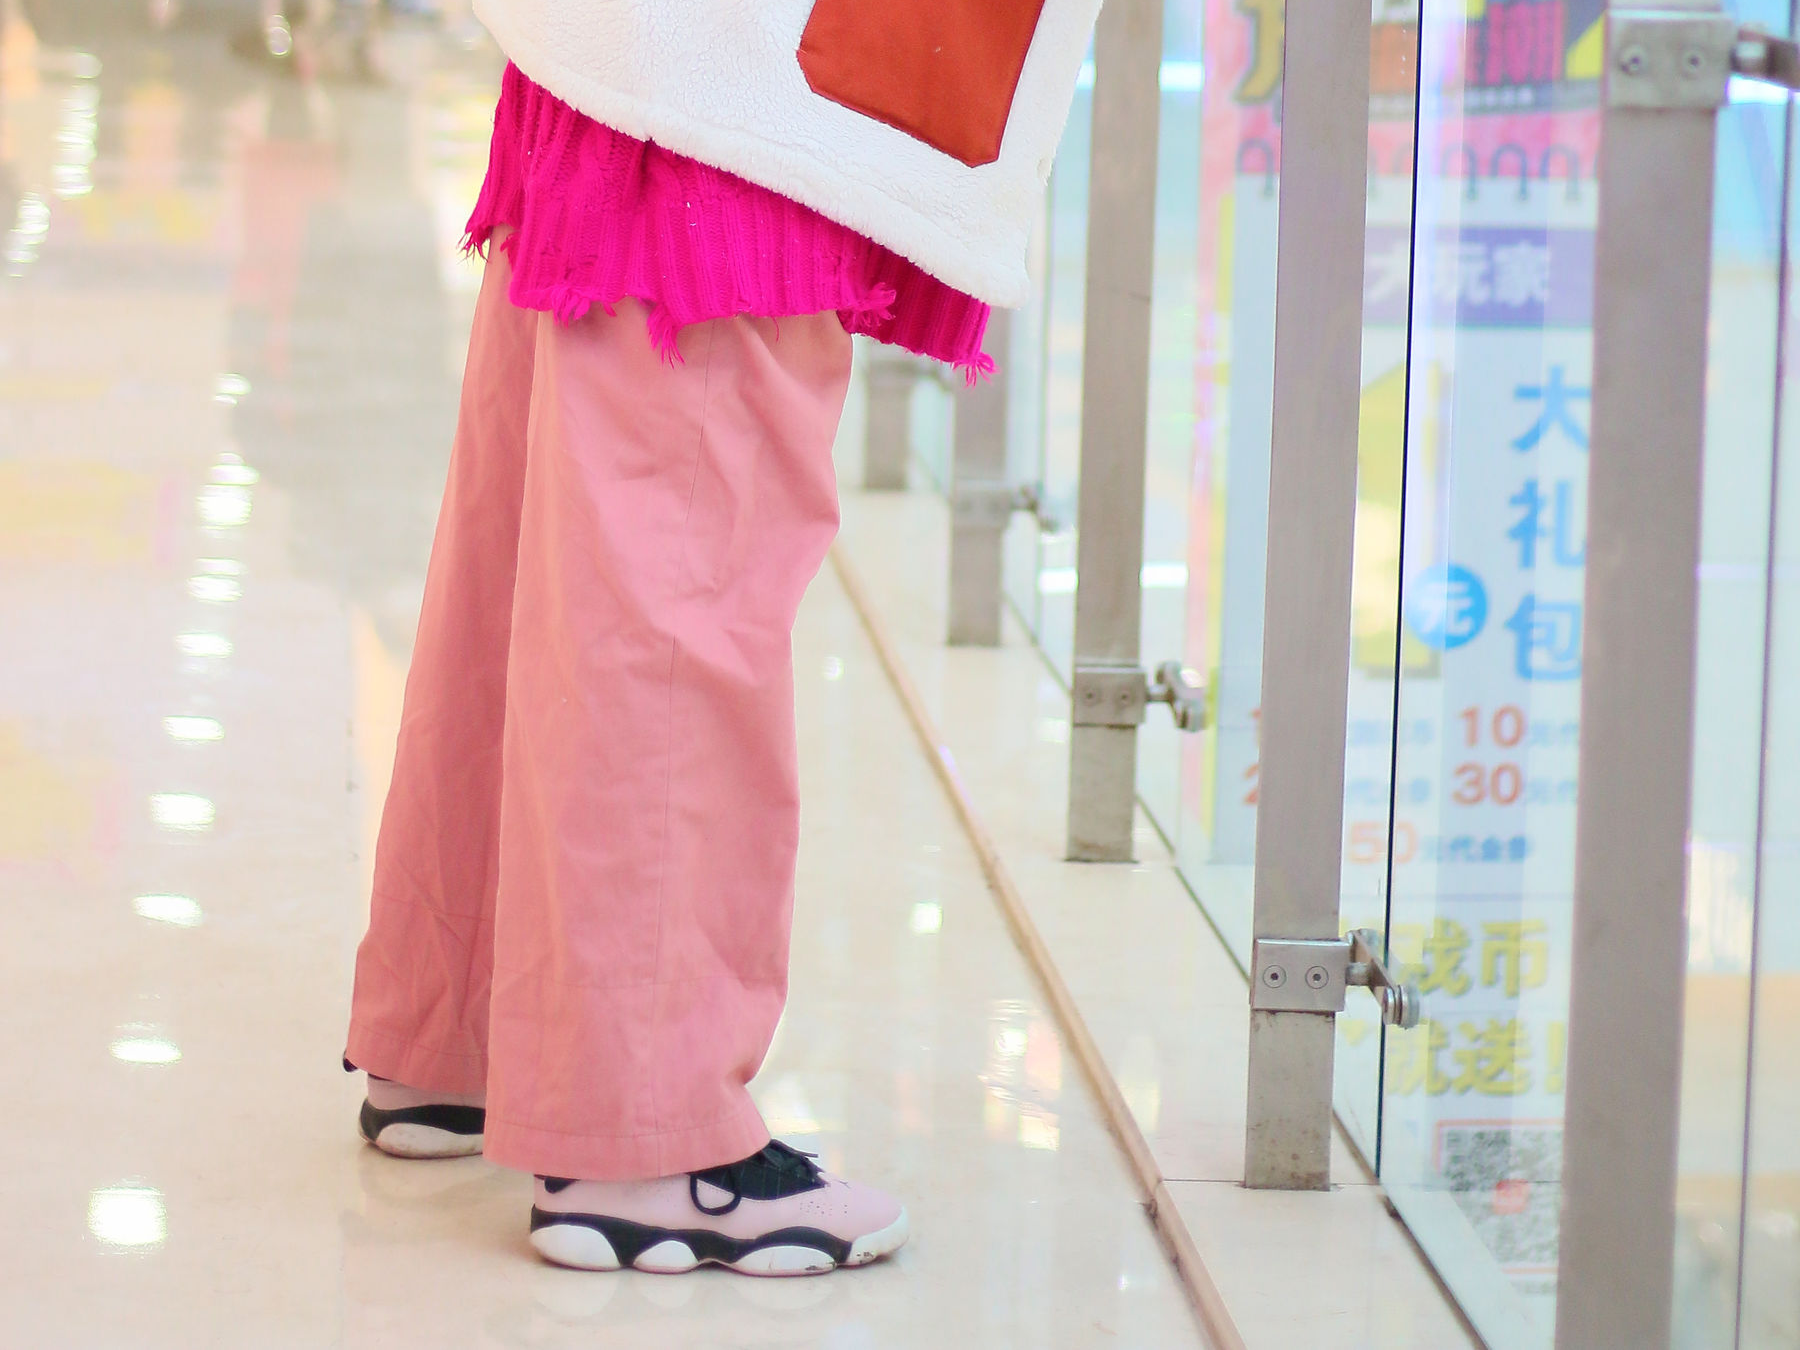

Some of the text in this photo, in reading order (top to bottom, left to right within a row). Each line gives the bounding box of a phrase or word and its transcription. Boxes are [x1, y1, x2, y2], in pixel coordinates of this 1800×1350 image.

[1503, 364, 1592, 681] 大礼包
[1340, 917, 1550, 997] 戏币
